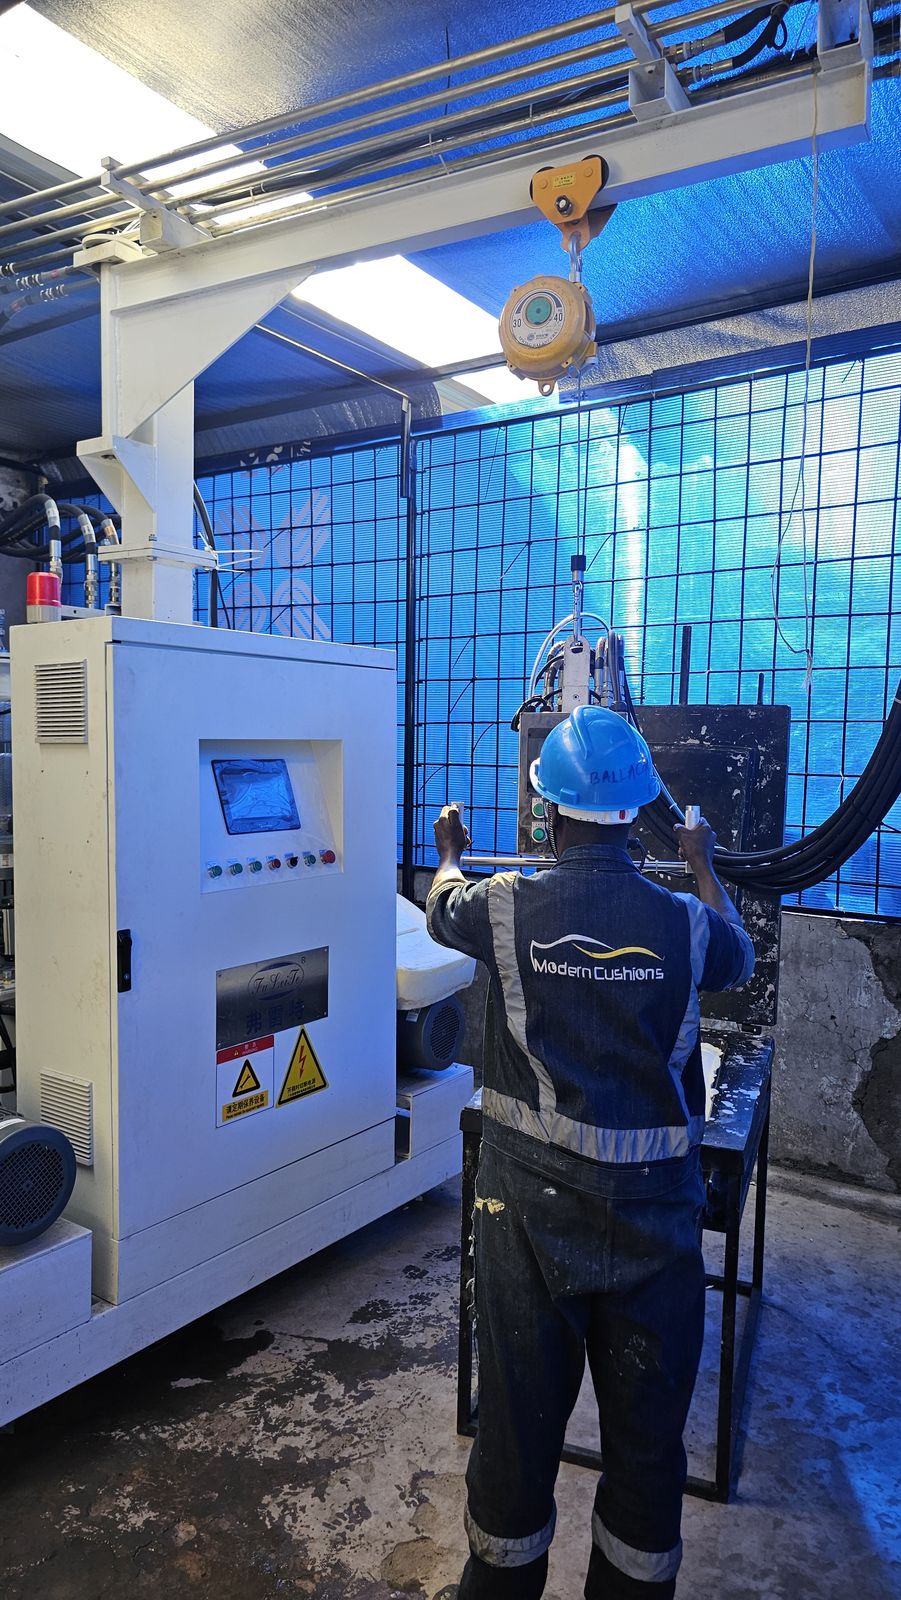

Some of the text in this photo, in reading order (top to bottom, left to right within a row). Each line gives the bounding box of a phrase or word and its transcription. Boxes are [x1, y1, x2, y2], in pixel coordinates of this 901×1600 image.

[554, 312, 563, 322] 40
[513, 318, 522, 328] 30
[532, 958, 664, 981] Modern Cushions
